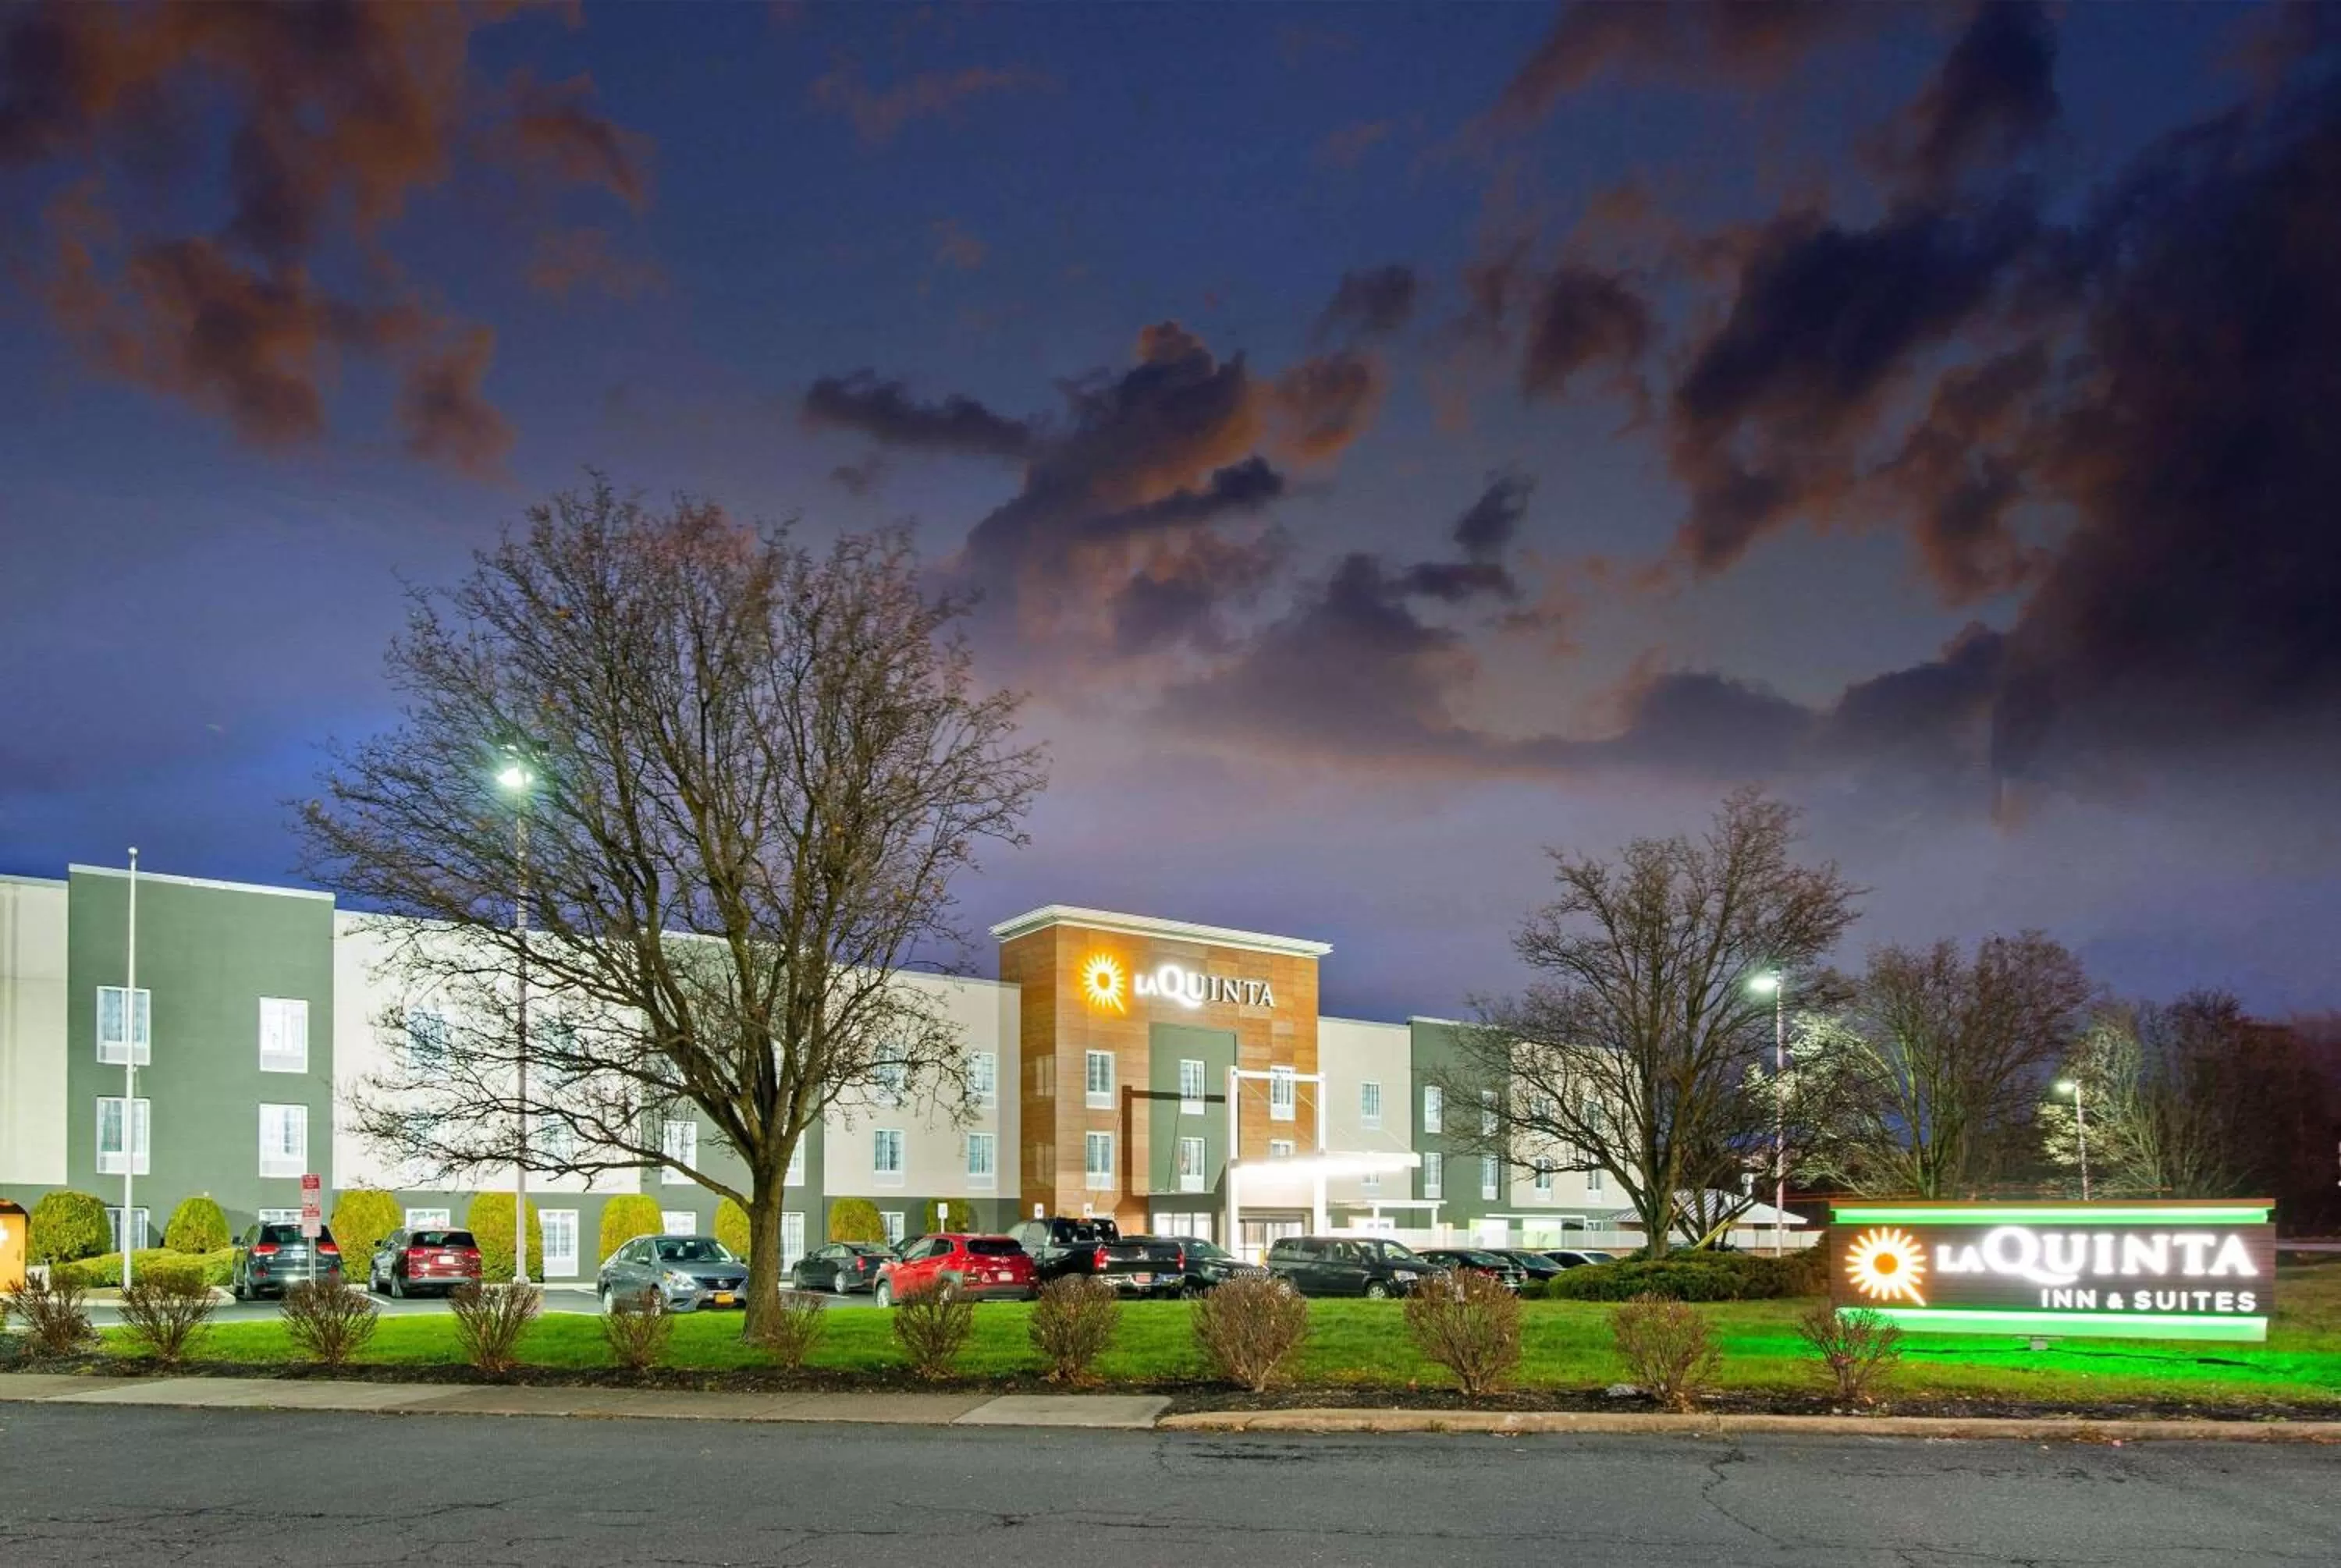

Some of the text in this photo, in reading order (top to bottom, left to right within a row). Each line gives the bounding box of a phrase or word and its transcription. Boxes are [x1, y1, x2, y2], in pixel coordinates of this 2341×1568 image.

[2041, 1289, 2257, 1311] INN & SUITES
